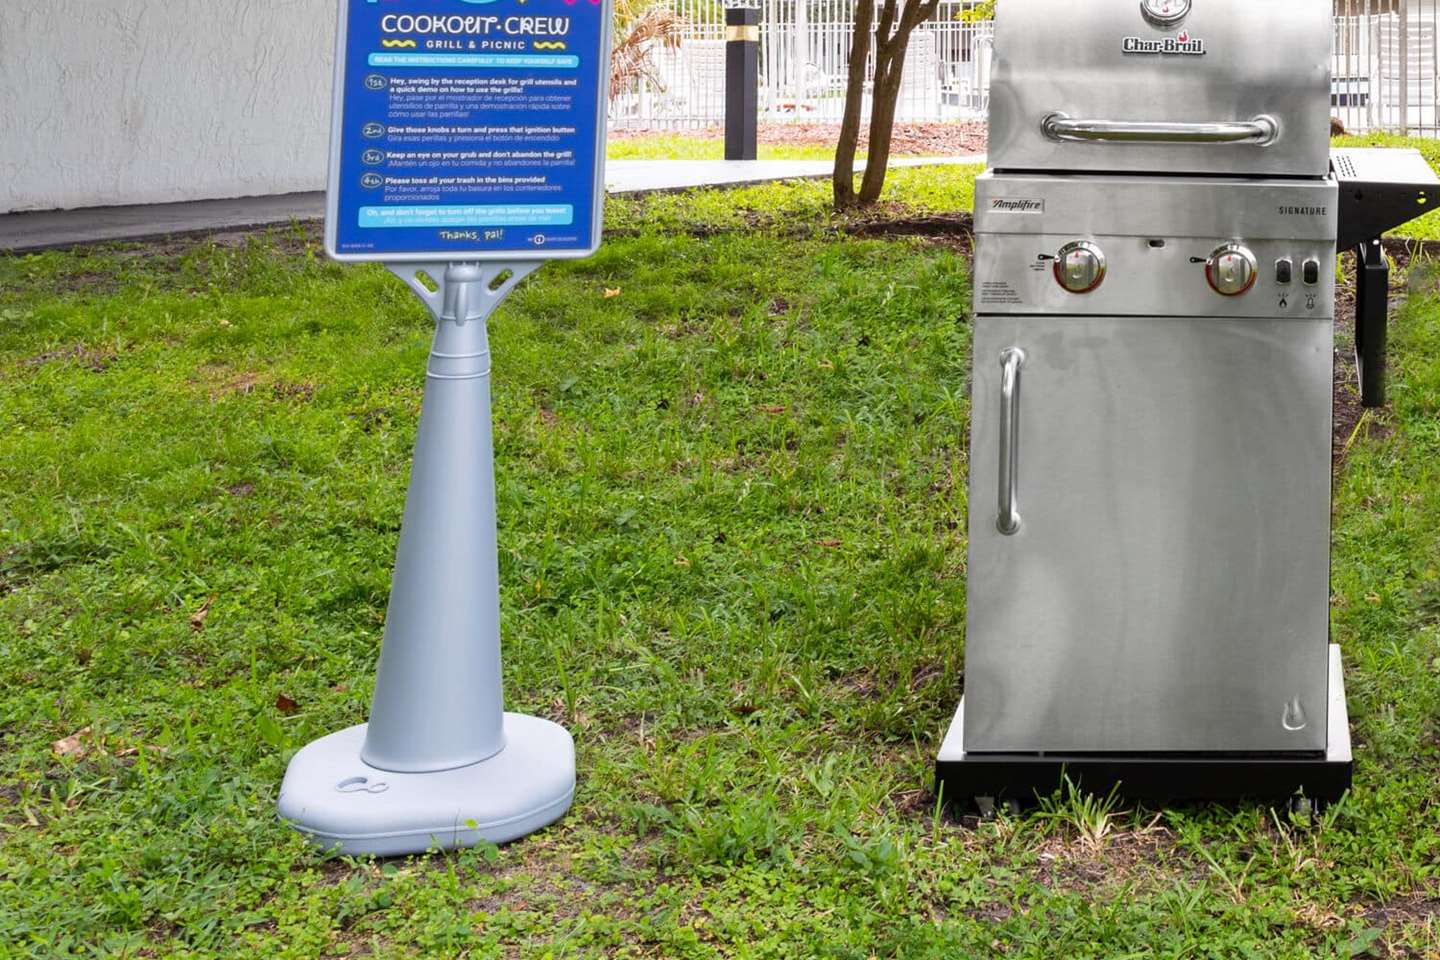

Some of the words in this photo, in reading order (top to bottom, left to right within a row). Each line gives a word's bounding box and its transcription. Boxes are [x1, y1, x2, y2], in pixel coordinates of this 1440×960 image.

[381, 14, 498, 34] COOKOUT
[504, 16, 570, 35] CREW
[426, 40, 463, 49] GRILL
[468, 41, 476, 49] &
[481, 41, 526, 50] PICNIC
[1123, 37, 1203, 52] Char-Broil
[992, 199, 1041, 211] Amplifire
[1278, 206, 1327, 216] SIGNATURE
[484, 228, 503, 240] pal!
